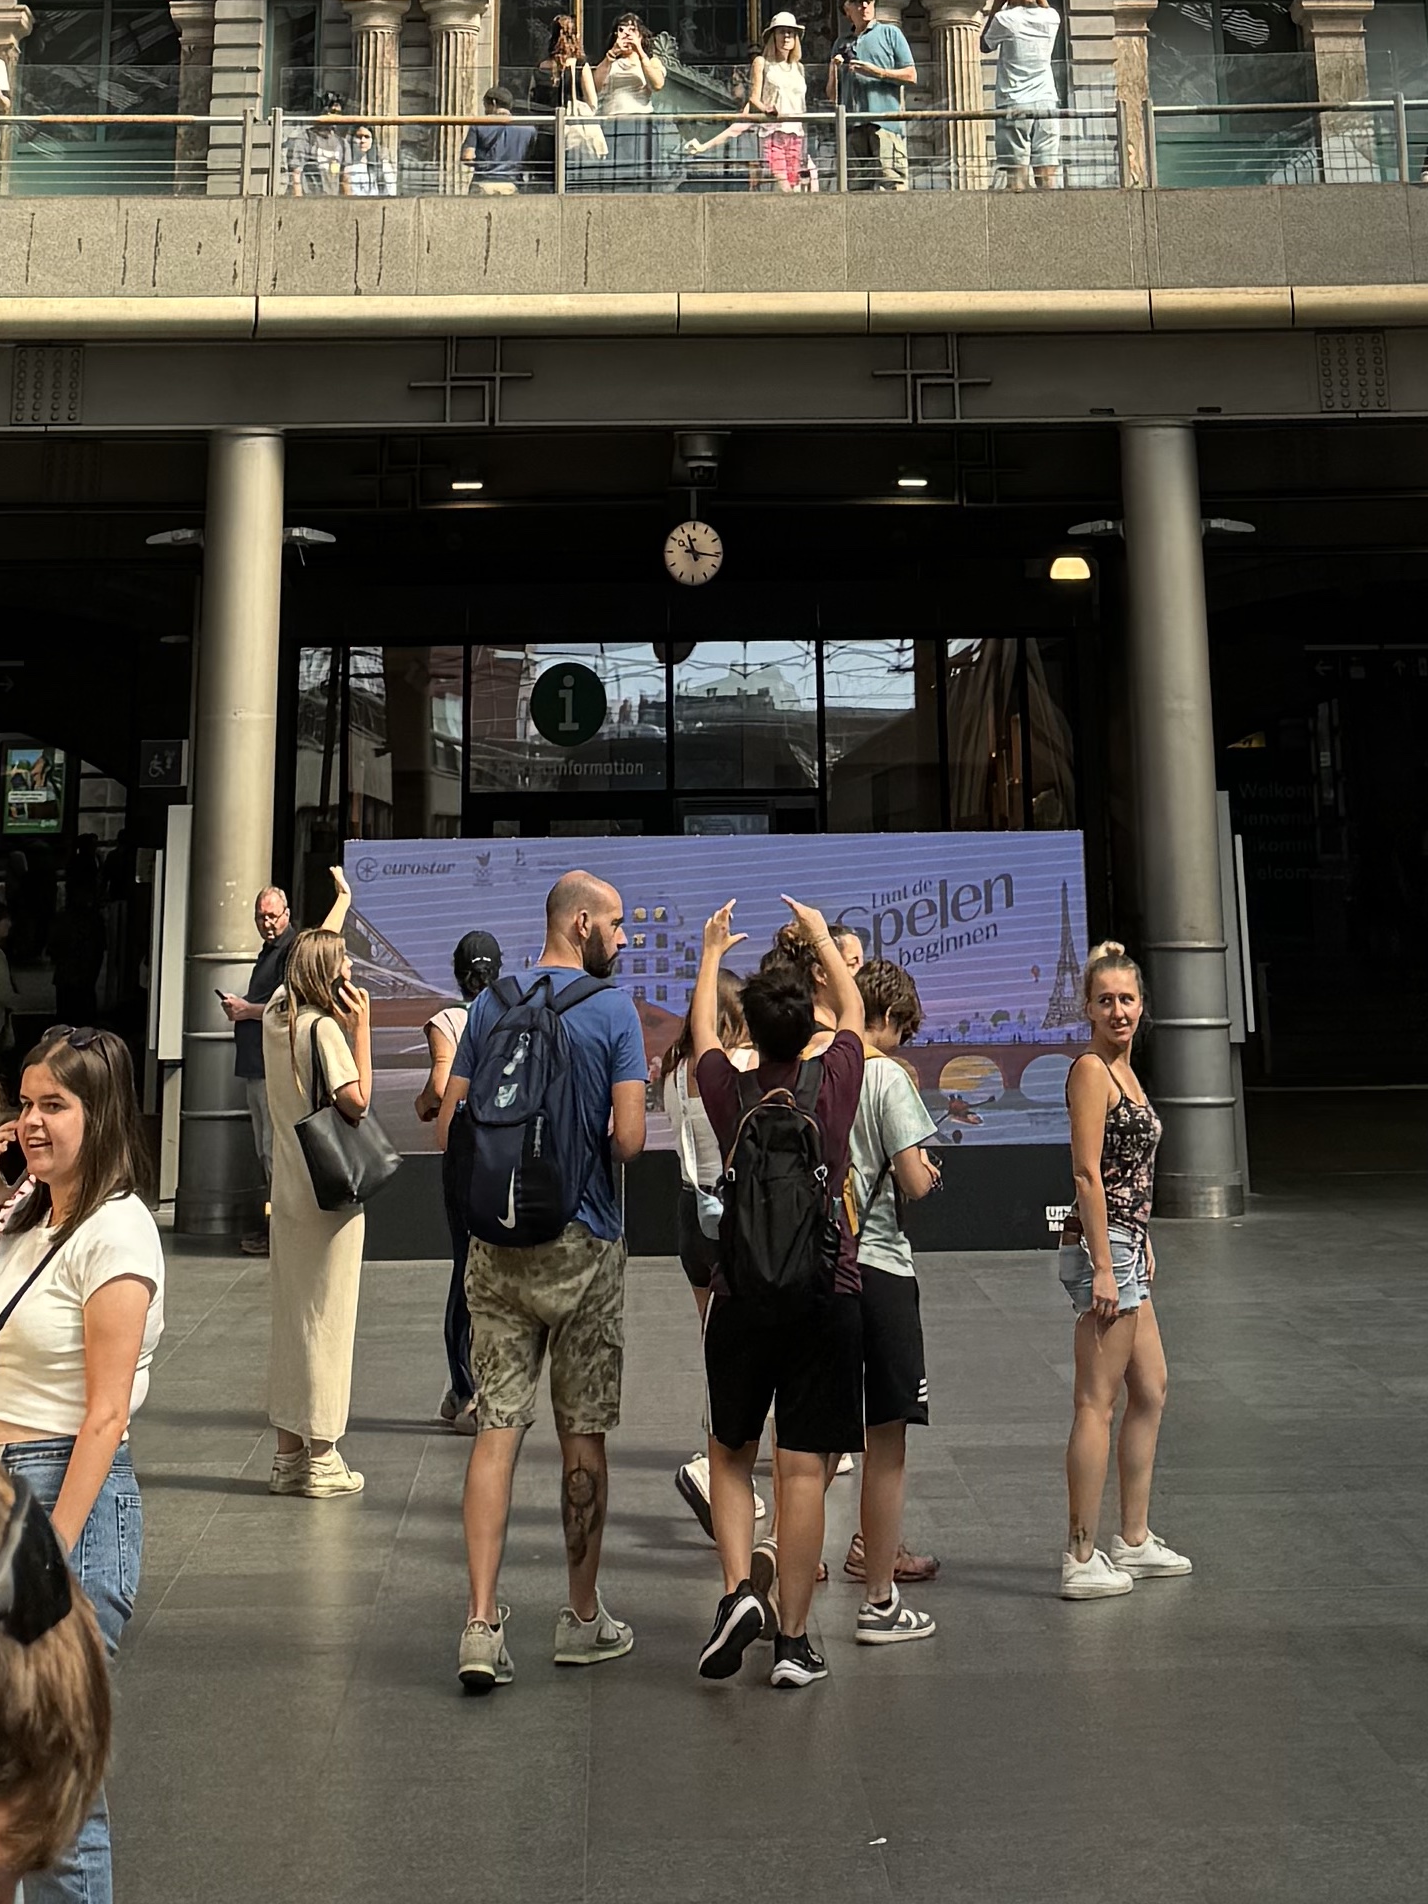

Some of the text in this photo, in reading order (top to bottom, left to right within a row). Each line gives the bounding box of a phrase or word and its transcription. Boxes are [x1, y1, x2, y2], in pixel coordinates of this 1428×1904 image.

[381, 862, 456, 877] eurostar
[911, 879, 933, 897] de
[898, 922, 999, 967] beginnen
